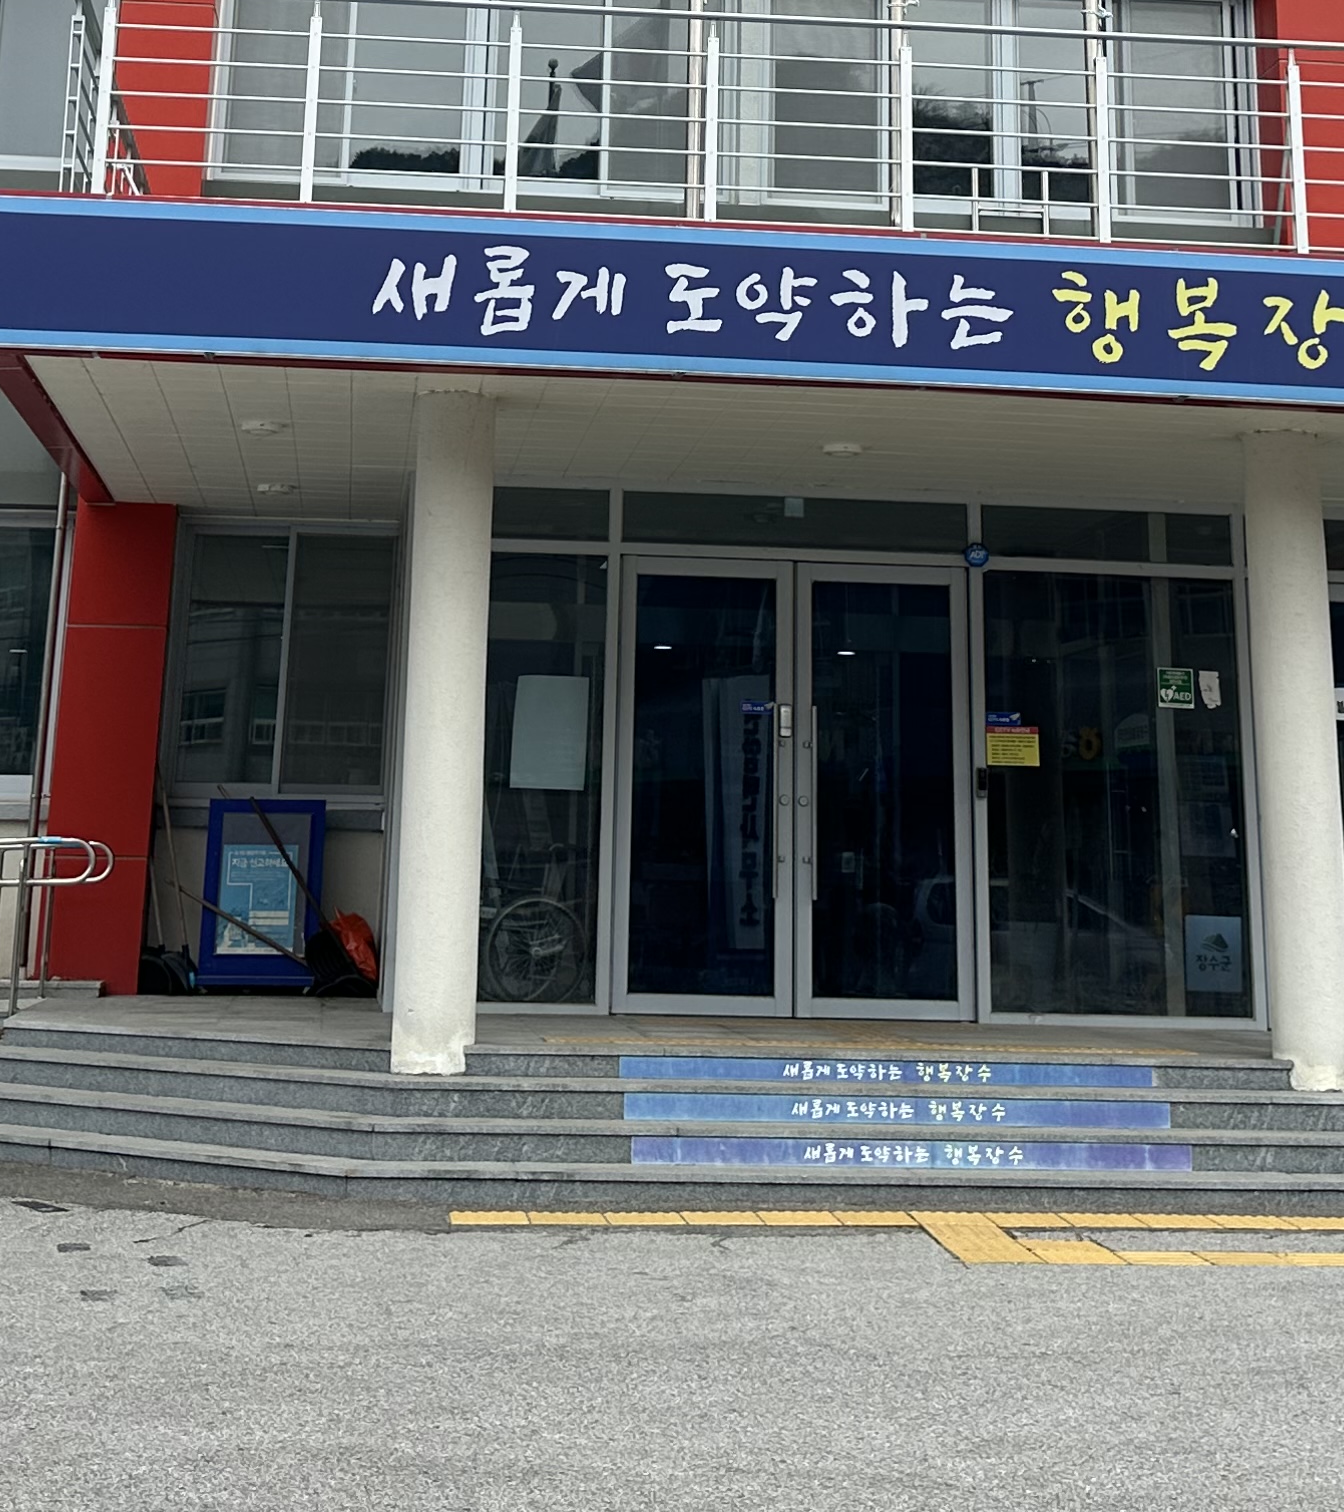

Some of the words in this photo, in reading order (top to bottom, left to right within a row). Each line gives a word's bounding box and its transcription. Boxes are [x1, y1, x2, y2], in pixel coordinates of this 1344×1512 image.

[372, 245, 627, 336] 새롭게
[664, 262, 1014, 350] 도약하는
[1173, 692, 1192, 701] AED
[1195, 953, 1233, 972] 장수군
[782, 1060, 830, 1081] 새롭게
[836, 1063, 902, 1081] 도약하는
[791, 1099, 840, 1120] 새롭게
[846, 1101, 914, 1119] 도약하는
[803, 1142, 854, 1163] 새롭게
[860, 1145, 930, 1163] 도약하는
